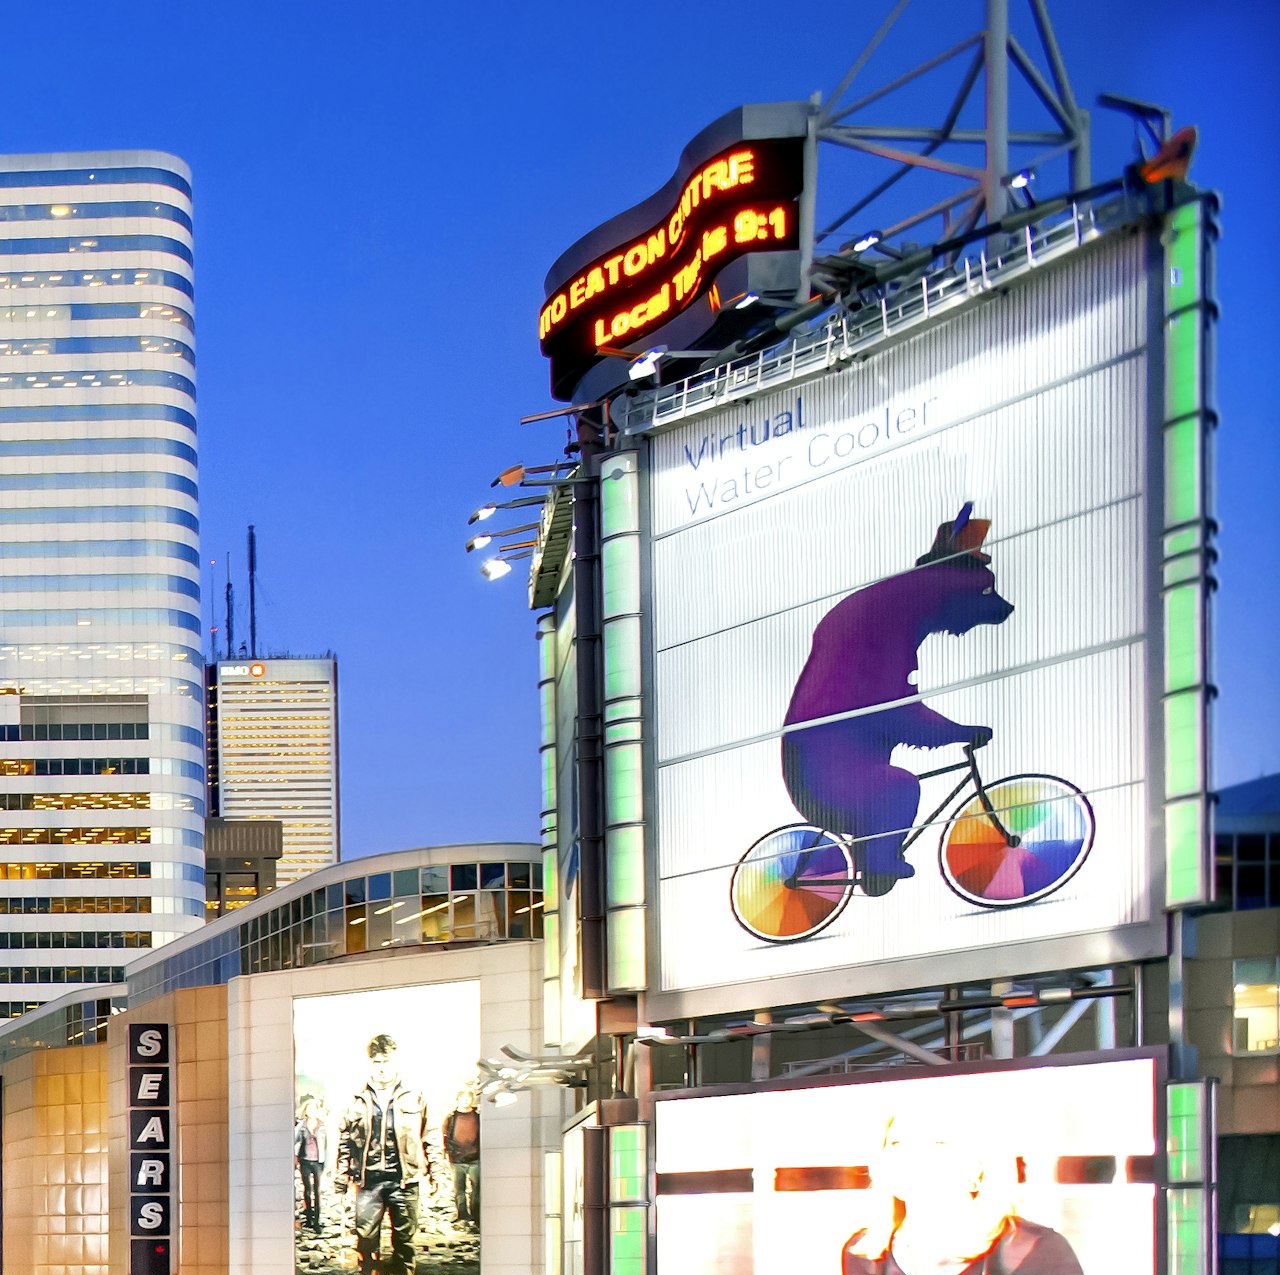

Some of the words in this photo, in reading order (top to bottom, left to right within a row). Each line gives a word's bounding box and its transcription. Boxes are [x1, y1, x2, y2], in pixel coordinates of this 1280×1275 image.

[570, 228, 664, 309] EATON
[595, 283, 650, 347] Local
[684, 396, 806, 470] Virtual
[685, 455, 792, 515] Water
[808, 397, 938, 468] Cooler
[137, 1029, 165, 1230] SEARS
